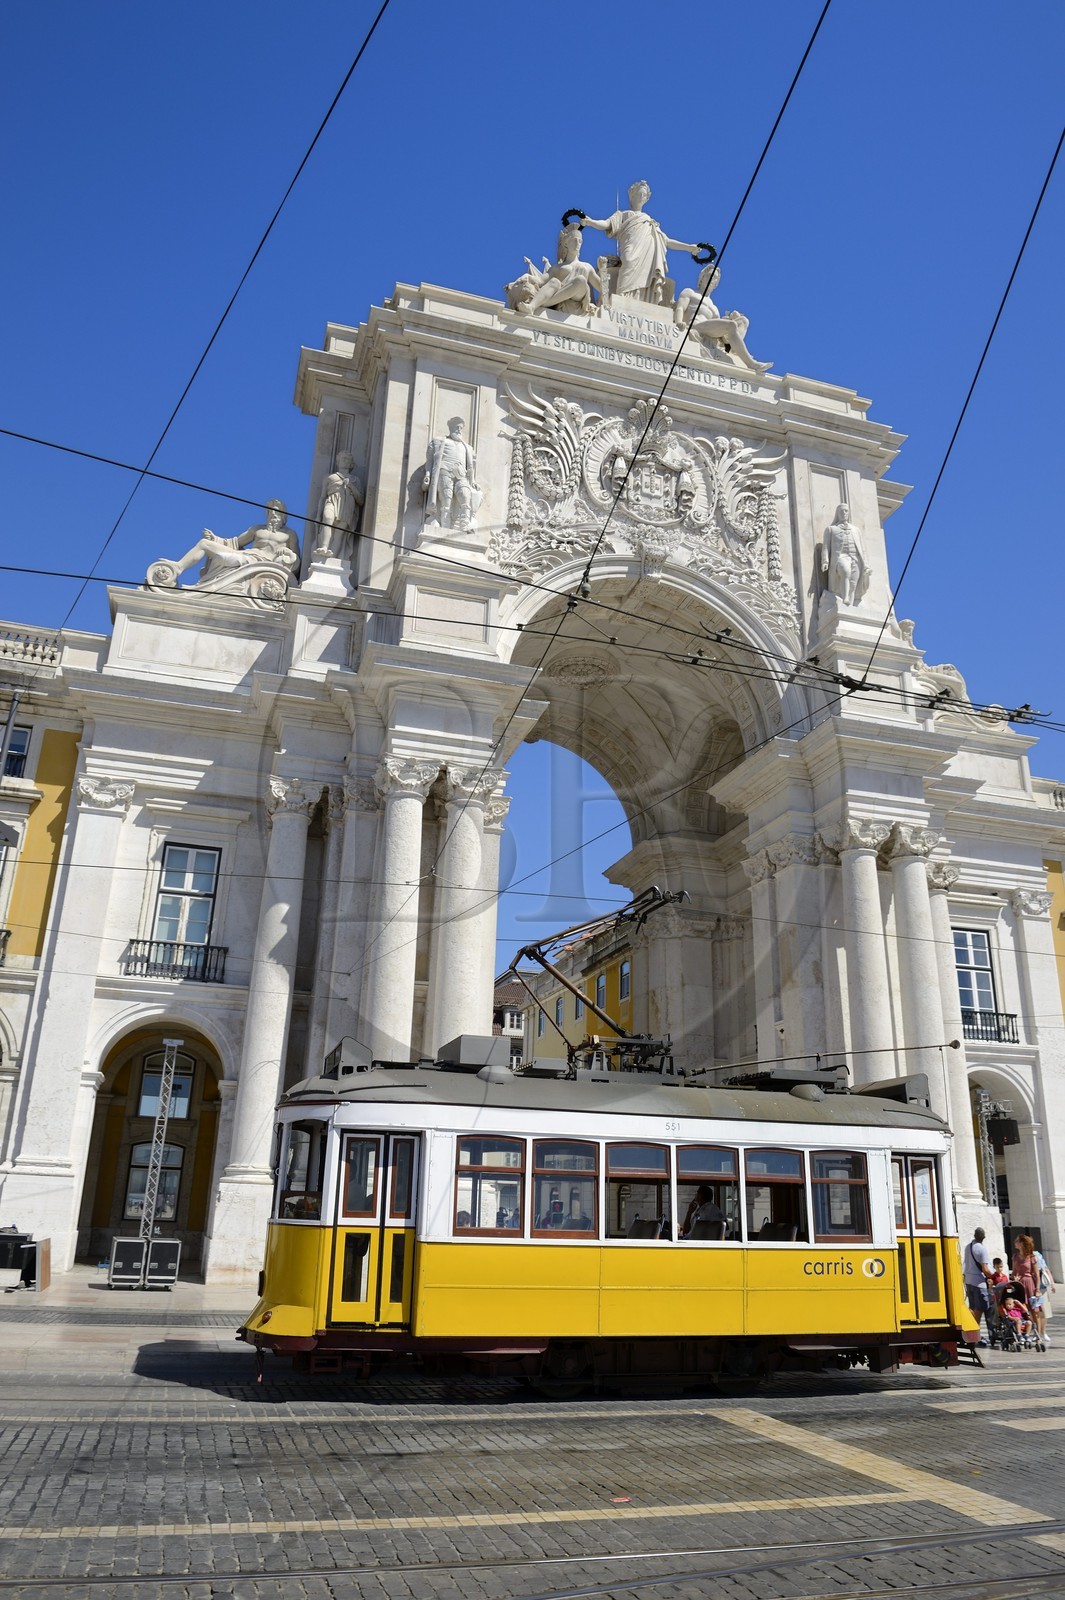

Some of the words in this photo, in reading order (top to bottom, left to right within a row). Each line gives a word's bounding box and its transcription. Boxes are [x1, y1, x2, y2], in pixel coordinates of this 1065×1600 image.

[608, 310, 679, 338] VIRTVTIBVS
[619, 326, 673, 349] MAIORVM
[665, 1122, 681, 1131] 551
[803, 1256, 854, 1275] carris
